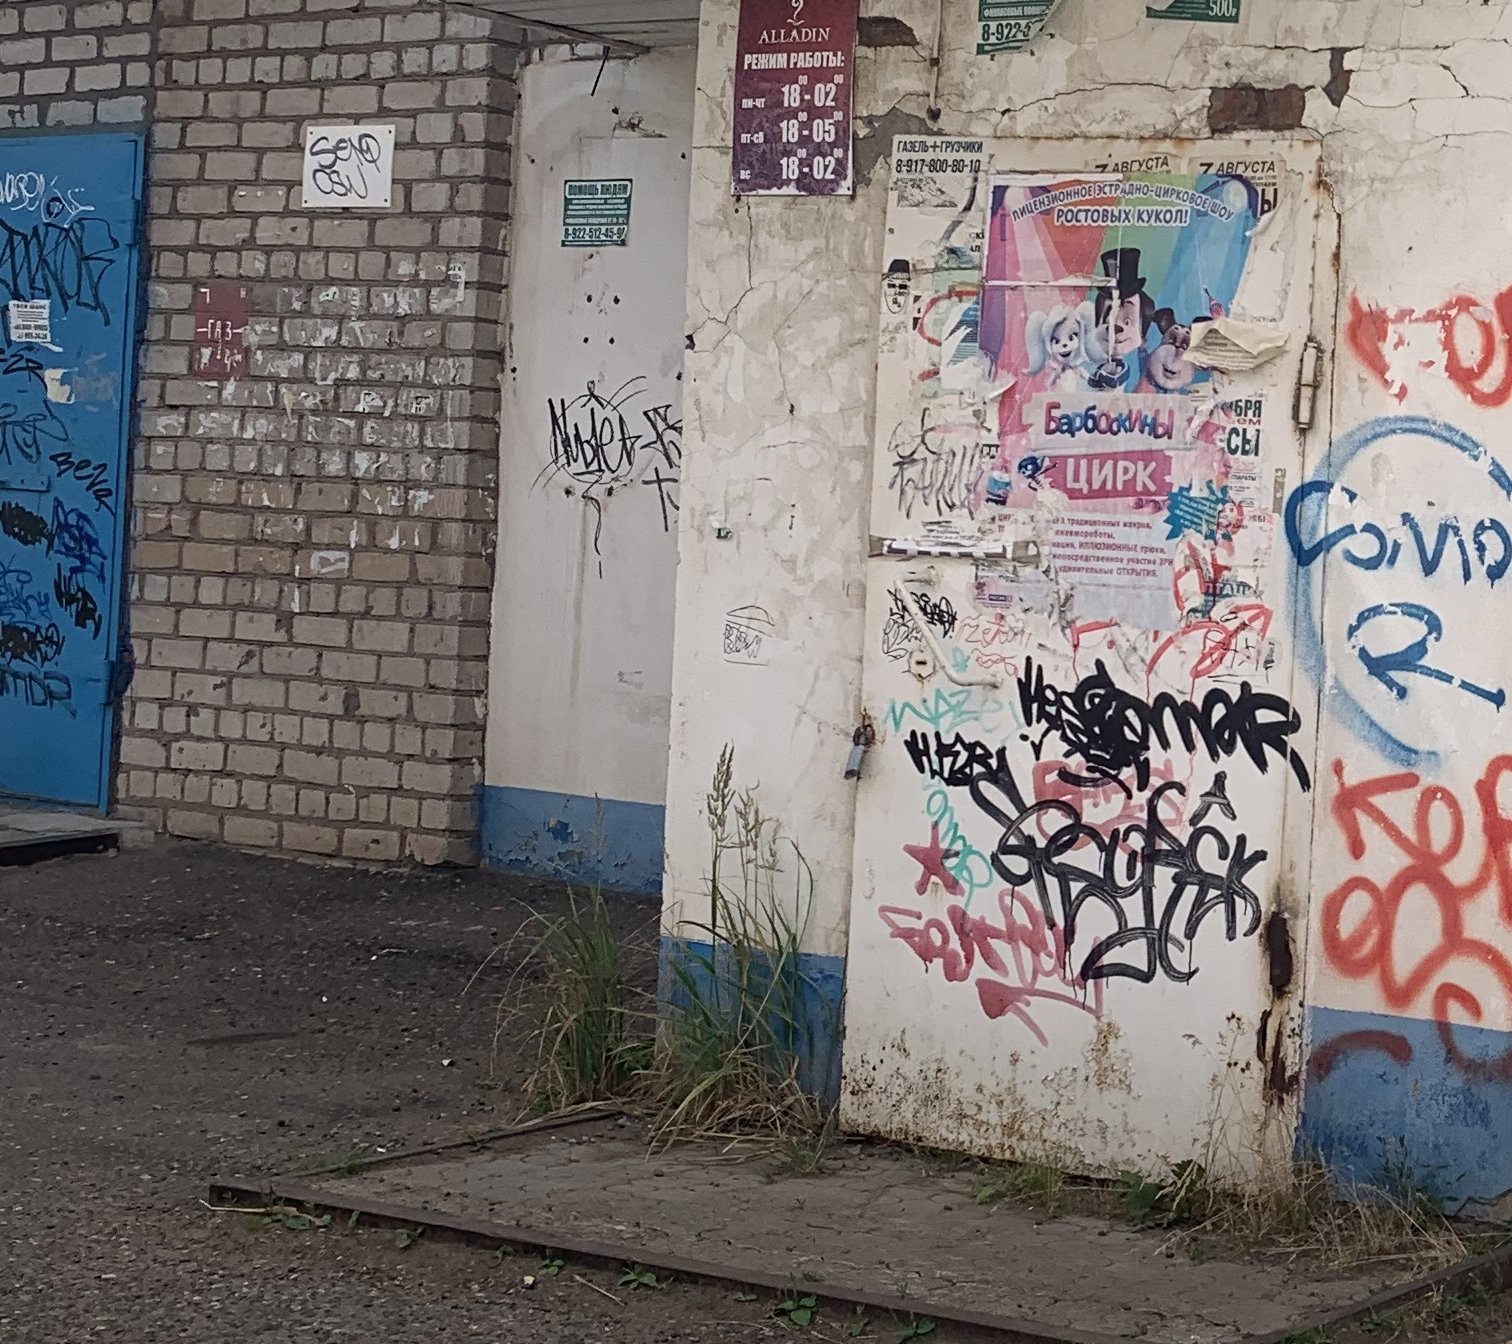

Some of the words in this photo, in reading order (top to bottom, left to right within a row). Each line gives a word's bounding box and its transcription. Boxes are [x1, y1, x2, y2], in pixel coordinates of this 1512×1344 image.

[758, 27, 831, 44] ALLADIN
[743, 53, 788, 70] РЕЖИМ
[789, 51, 845, 69] РАБОТЫ:
[1216, 160, 1276, 174] АВГУСТА
[1012, 186, 1094, 223] ЛИЦЕНЗИОННОЕ
[1210, 201, 1235, 222] ШОУ
[1056, 208, 1132, 224] РОСТОВЫХ
[1136, 209, 1190, 224] КУКОЛ!
[1066, 457, 1158, 494] ЦИРК
